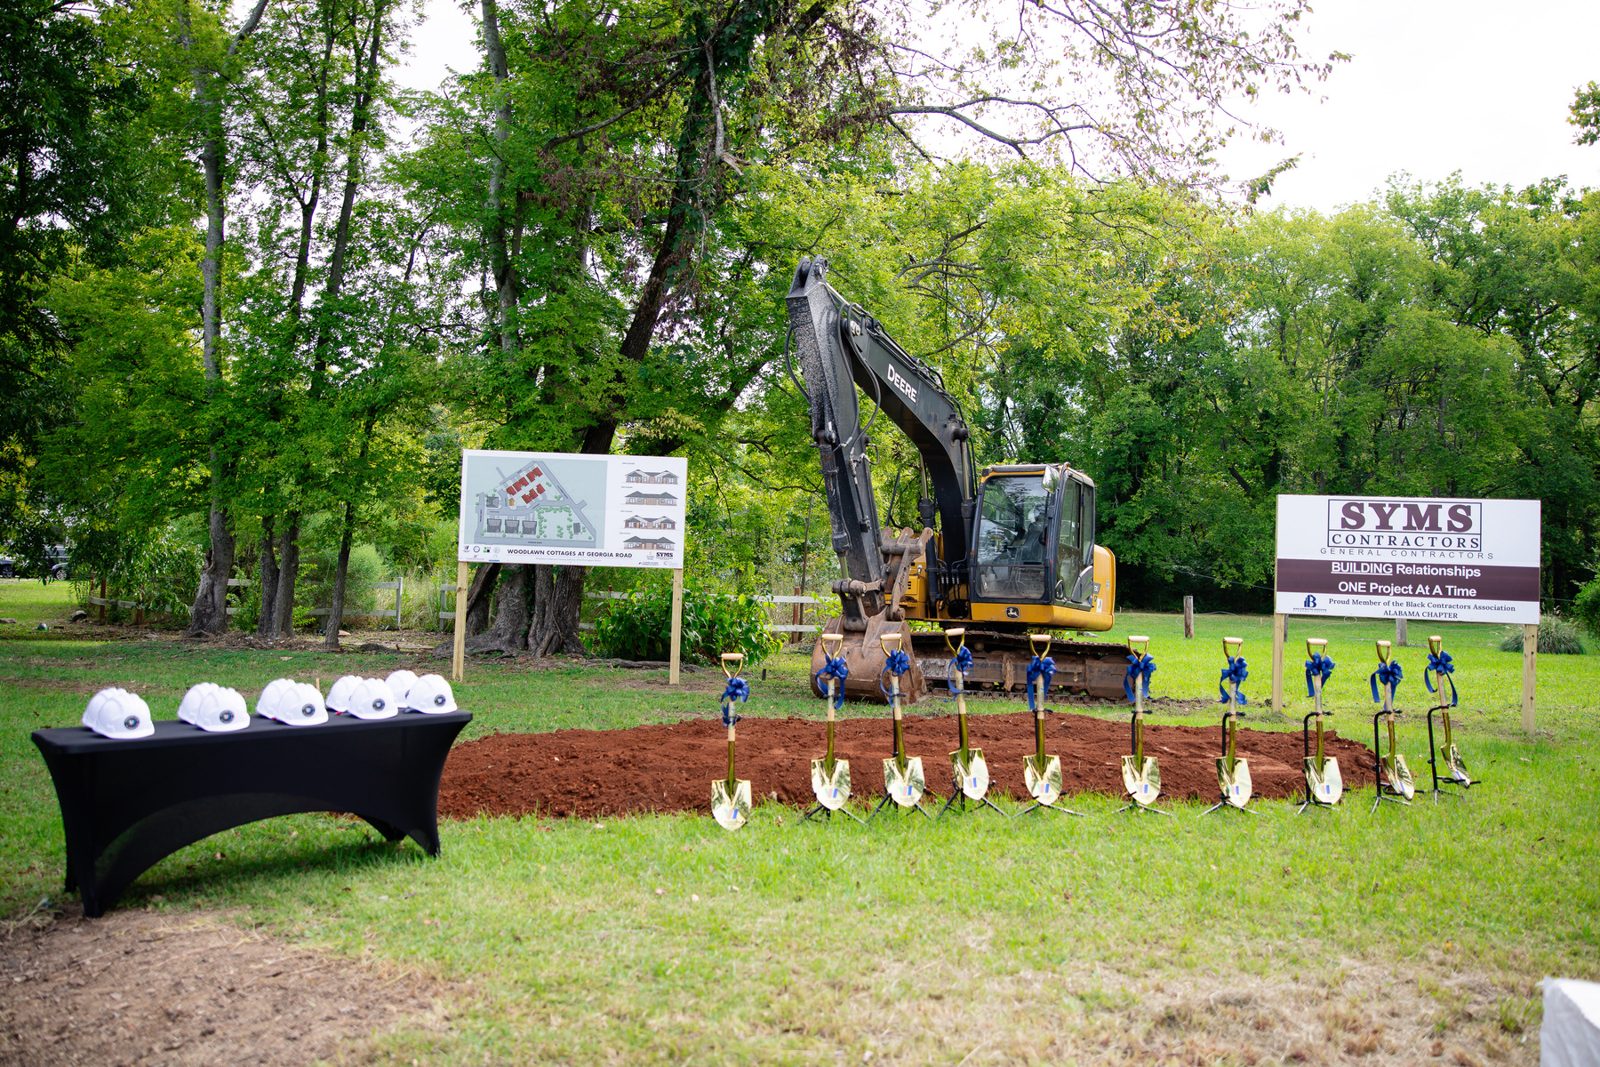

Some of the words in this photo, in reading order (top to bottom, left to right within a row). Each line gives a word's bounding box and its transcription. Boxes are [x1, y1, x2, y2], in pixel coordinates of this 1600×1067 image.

[887, 363, 917, 403] DEERE
[1340, 502, 1473, 533] SYMS
[1332, 534, 1479, 549] CONTRACTORS
[1320, 547, 1381, 557] GENERAL
[1391, 549, 1494, 560] CONTRACTORS
[1331, 561, 1393, 575] BUILDING
[1396, 564, 1481, 579] Relationships
[1338, 581, 1367, 593] ONE
[1369, 582, 1413, 596] Project
[1415, 584, 1431, 596] At
[1432, 585, 1443, 596] A
[1445, 585, 1477, 597] Time
[1427, 602, 1471, 610] Contractors
[1473, 604, 1516, 612] Association
[1421, 611, 1458, 619] CHAPTER
